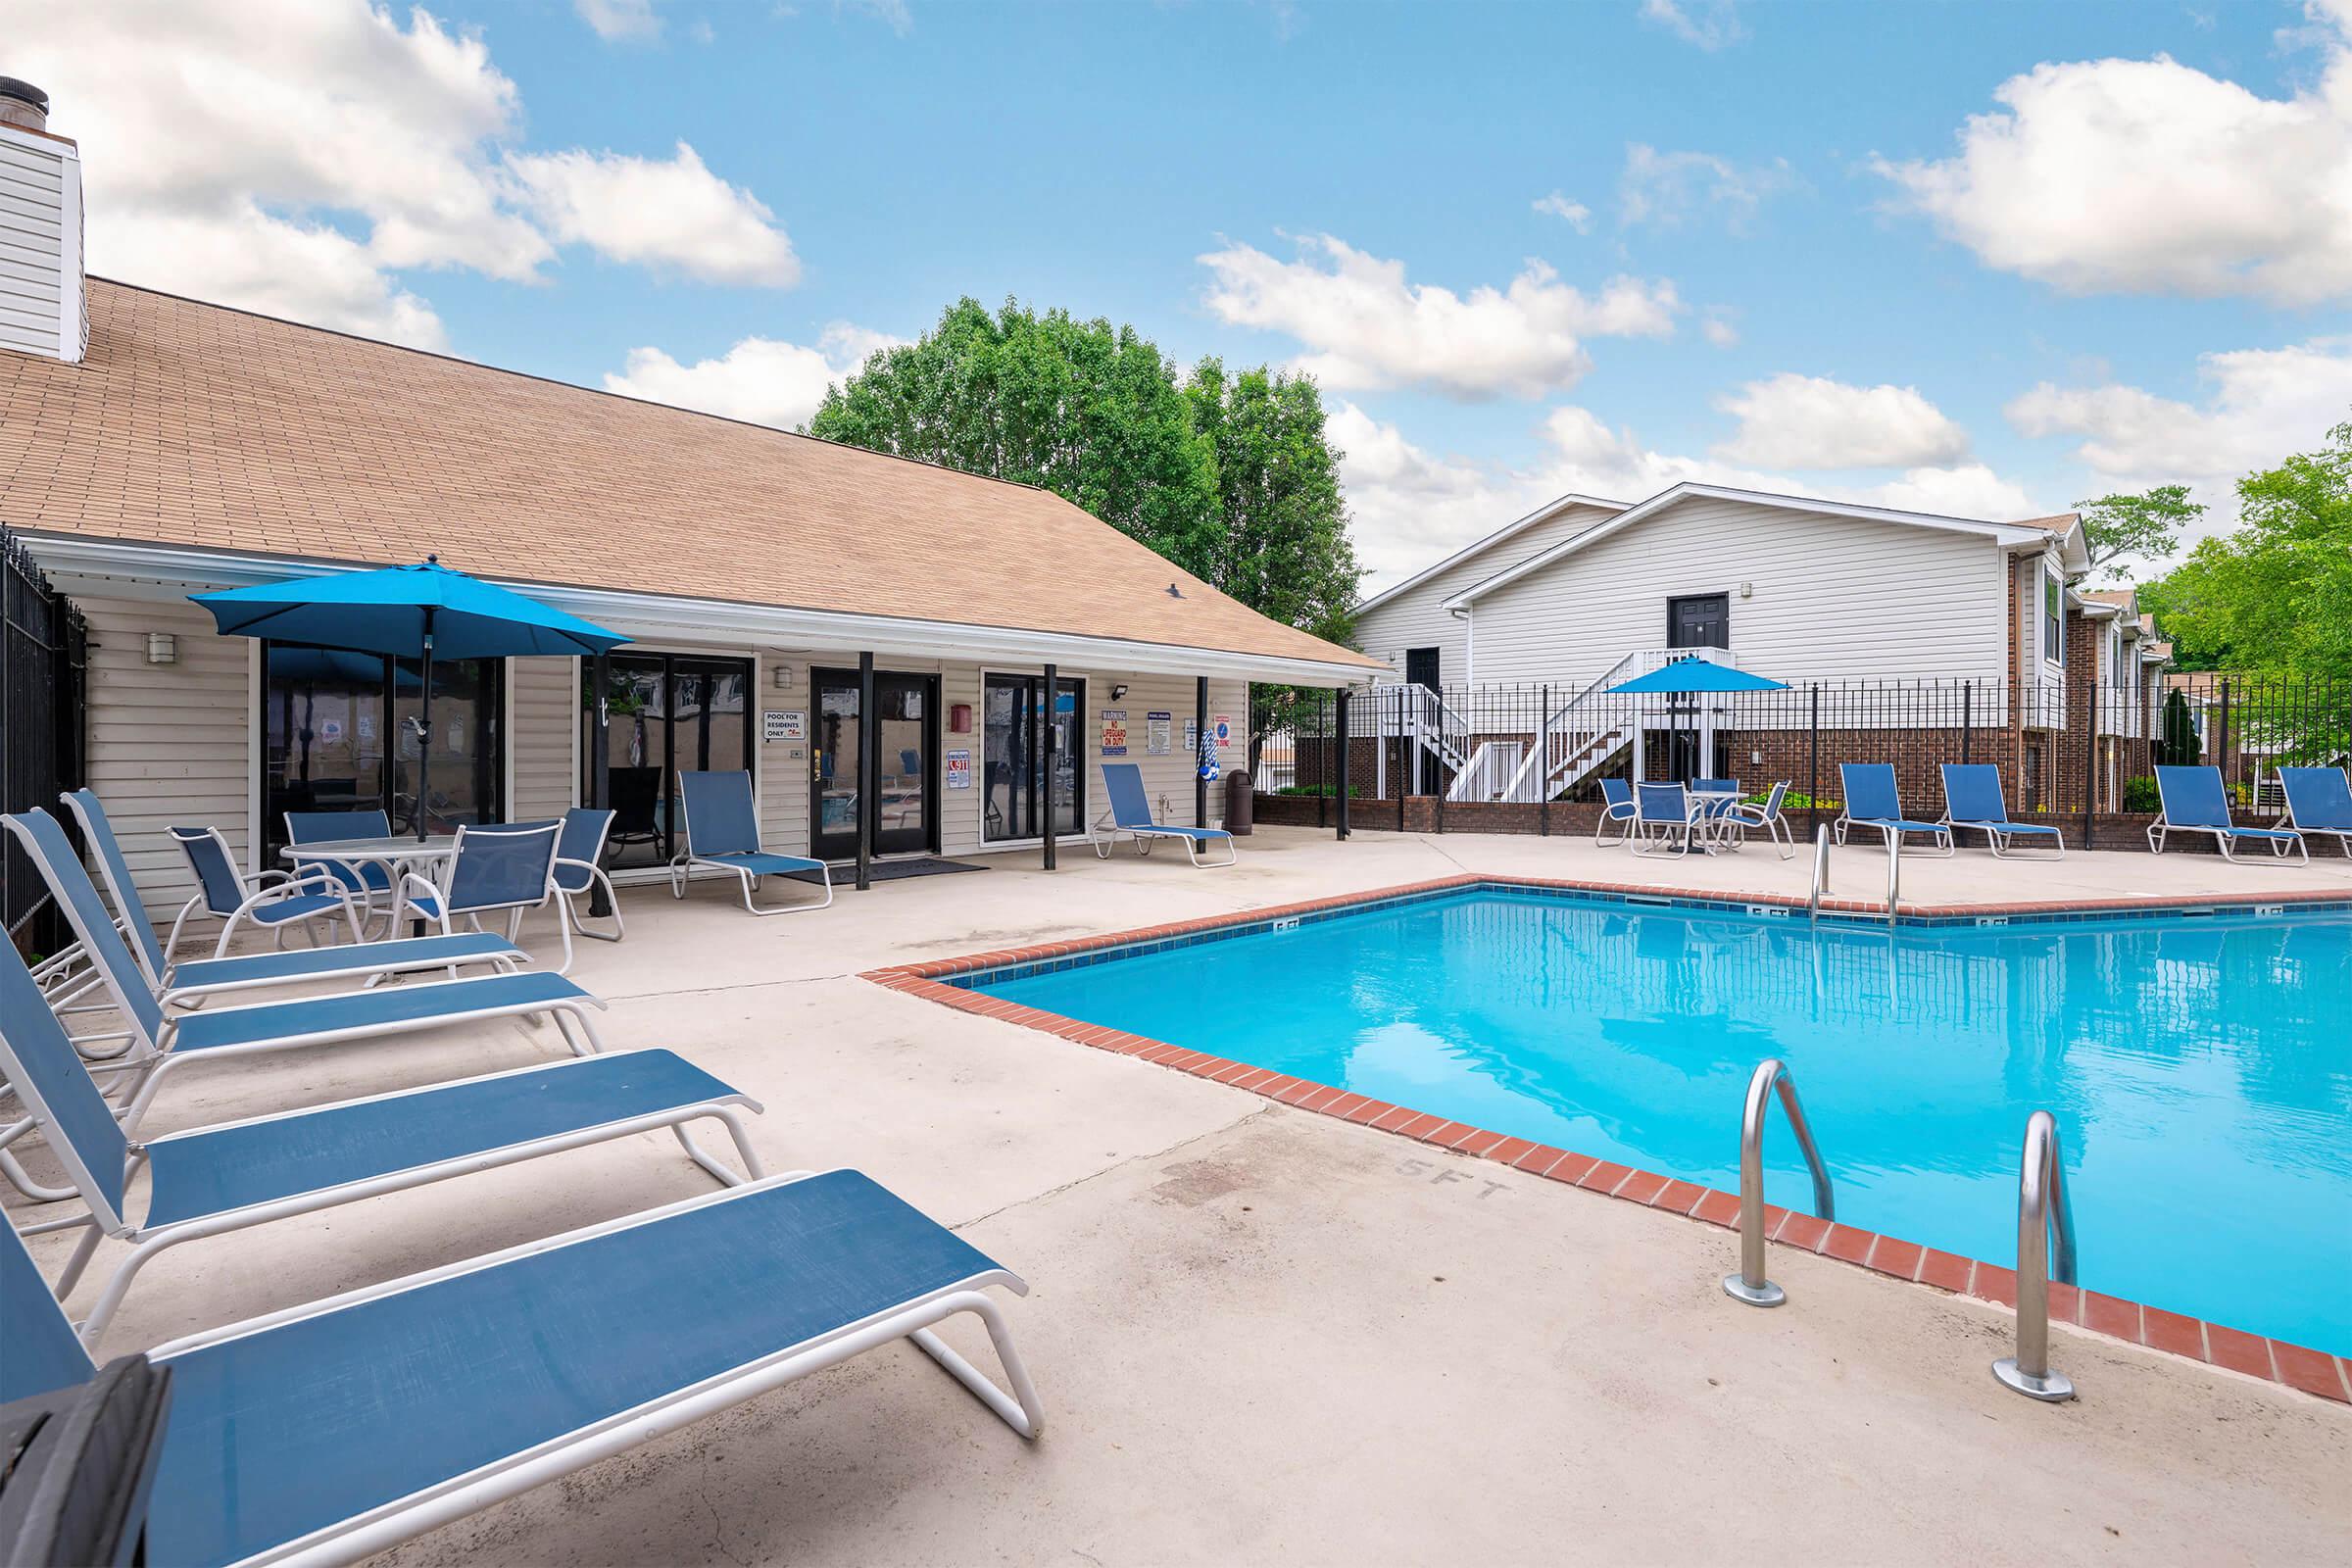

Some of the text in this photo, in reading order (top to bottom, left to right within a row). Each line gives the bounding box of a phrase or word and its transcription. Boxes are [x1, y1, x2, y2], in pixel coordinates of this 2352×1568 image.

[1102, 710, 1127, 720] WARNING
[1111, 720, 1118, 729] NO
[1102, 728, 1126, 737] LIFEGUARD
[956, 760, 968, 770] 911
